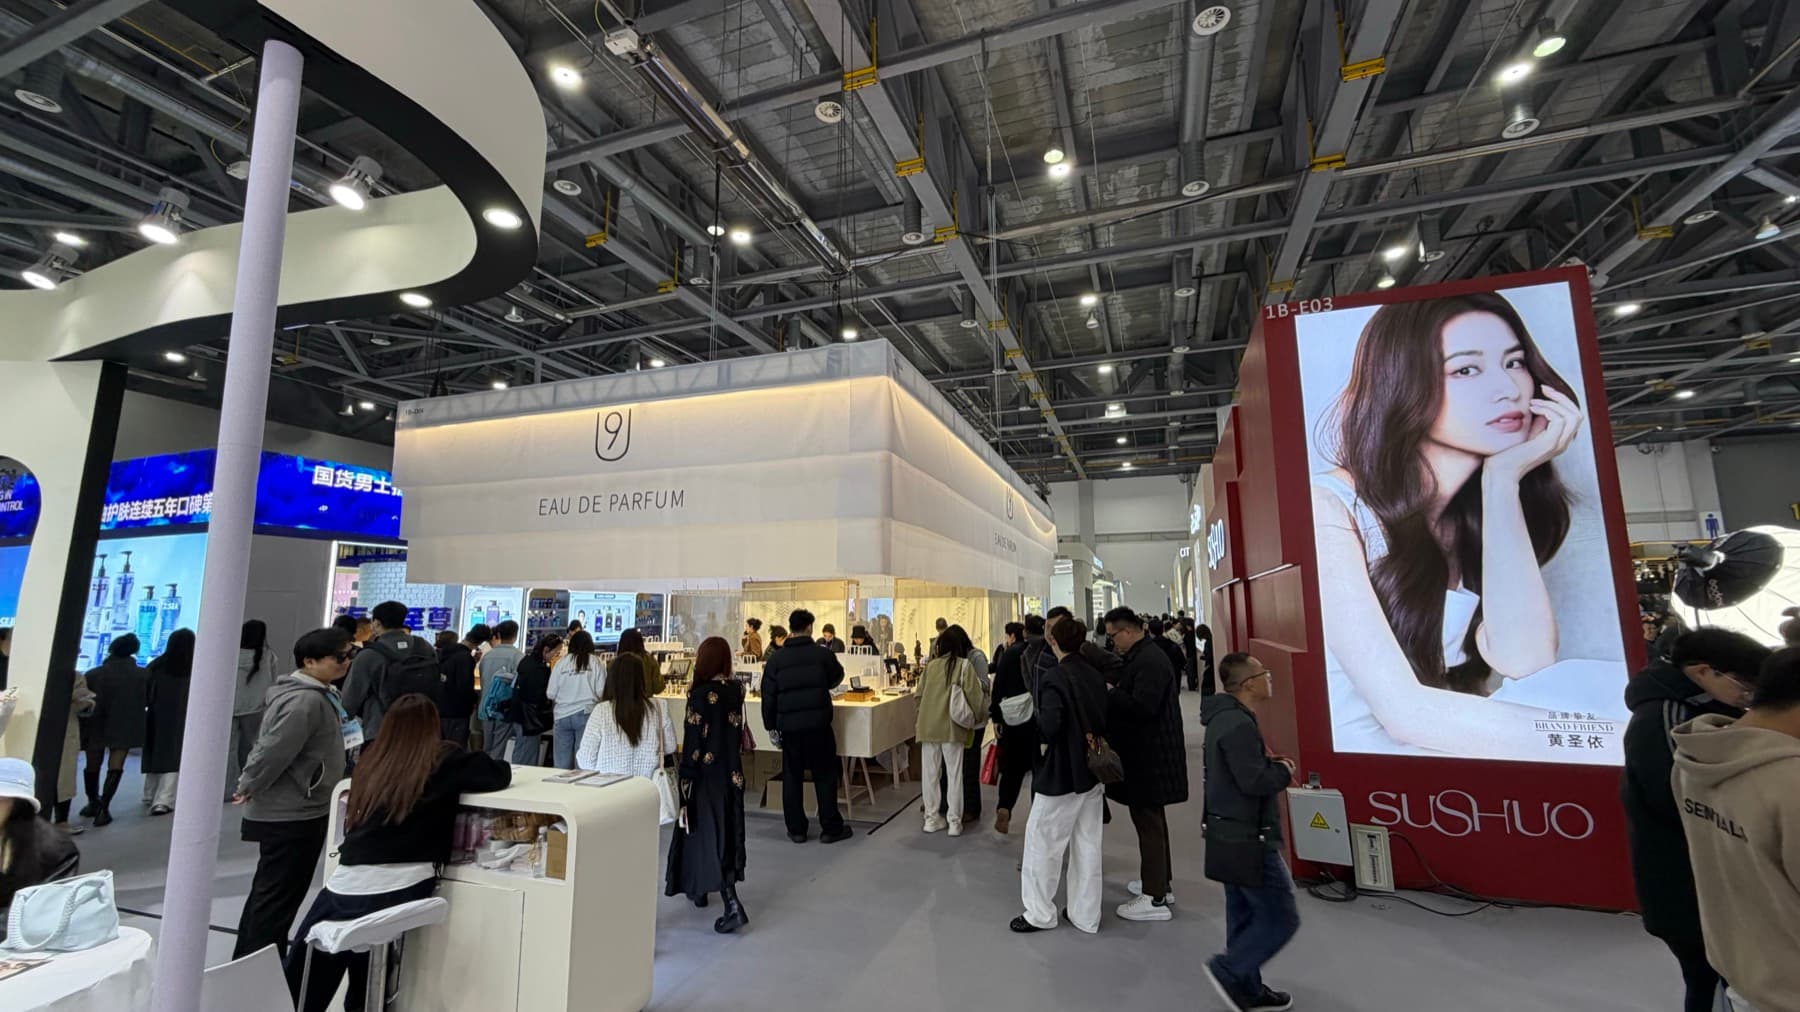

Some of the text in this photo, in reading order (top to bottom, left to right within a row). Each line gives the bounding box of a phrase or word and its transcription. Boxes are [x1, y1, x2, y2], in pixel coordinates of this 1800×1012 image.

[1266, 297, 1334, 319] 1B-E03
[539, 489, 684, 516] EAU DE PARFUM
[1535, 721, 1614, 732] BRAND FRIEND
[1547, 733, 1604, 749] 黄圣依
[1368, 789, 1594, 840] SUSHUO
